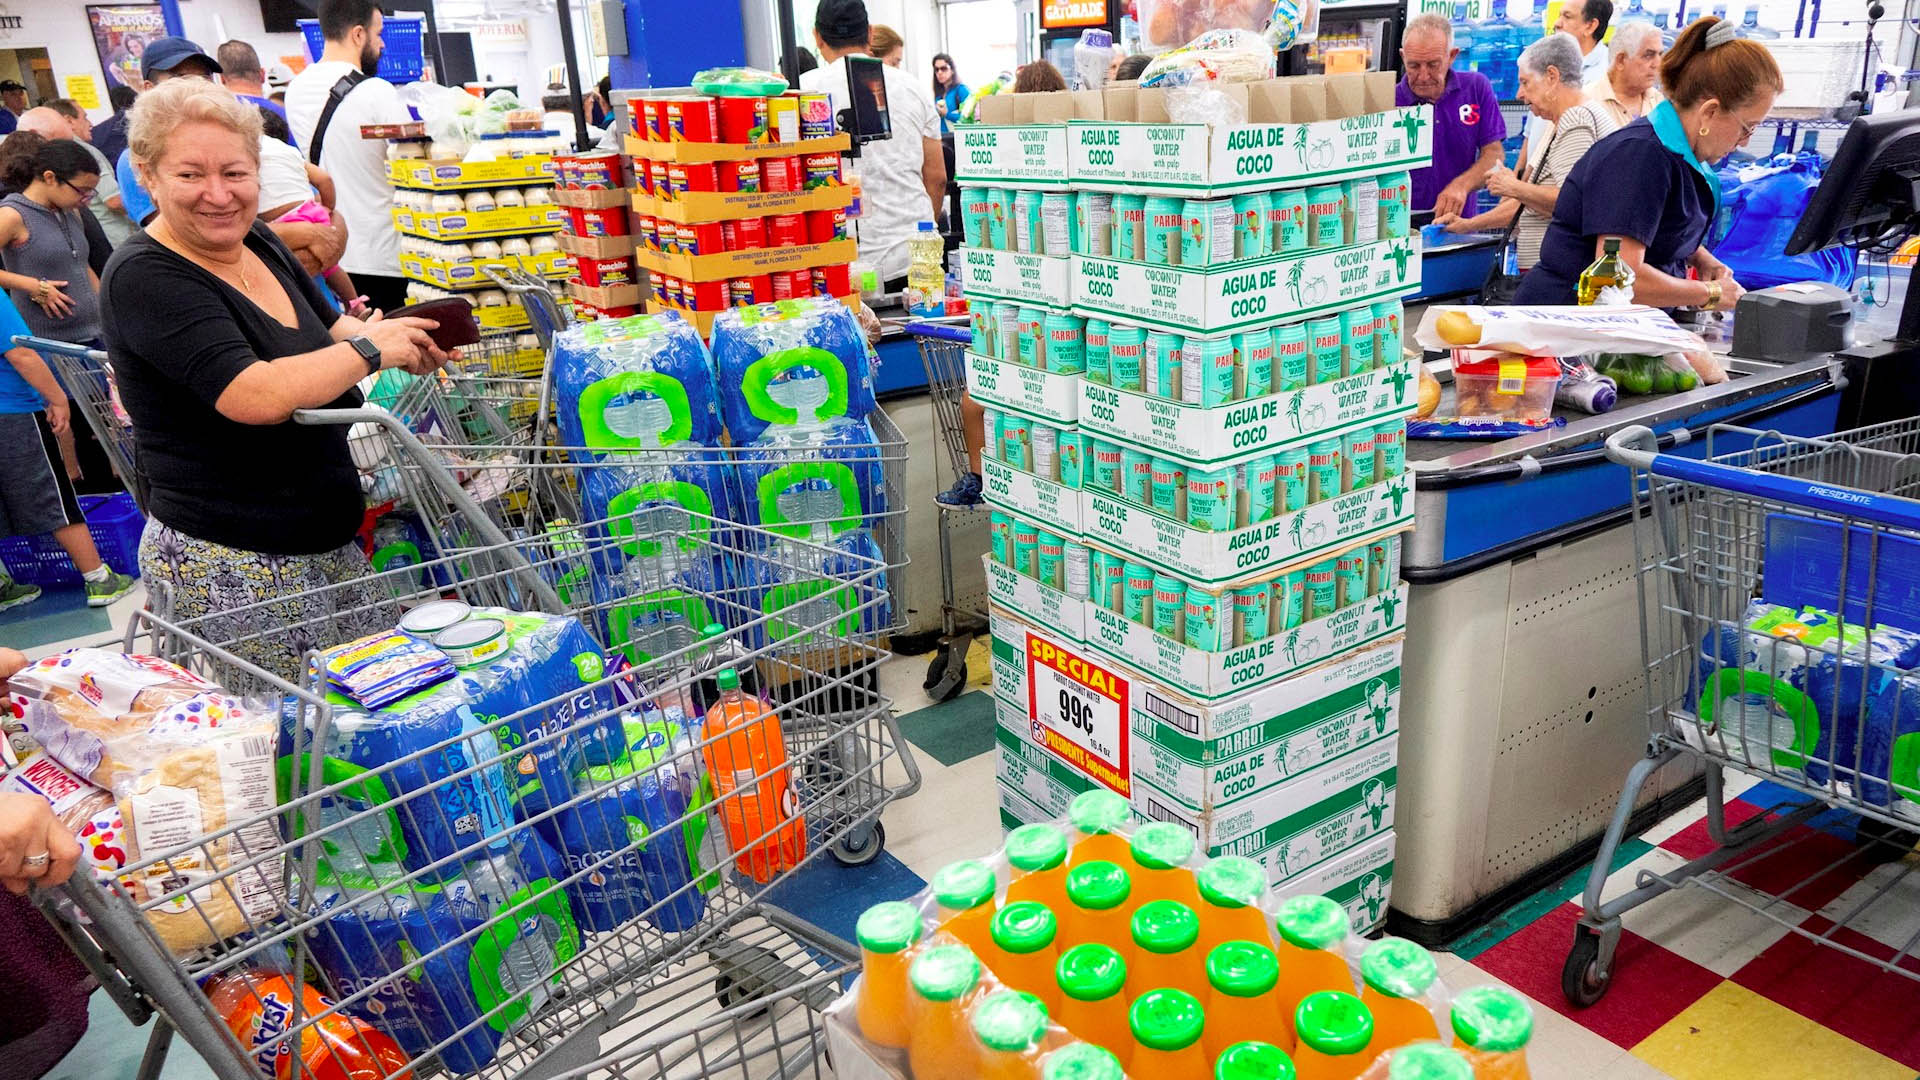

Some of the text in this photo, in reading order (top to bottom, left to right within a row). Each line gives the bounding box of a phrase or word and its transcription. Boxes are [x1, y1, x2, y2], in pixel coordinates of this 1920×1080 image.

[1046, 2, 1104, 19] GATORADE
[1340, 114, 1385, 132] COCONUT
[965, 133, 997, 147] AGUA DE
[1018, 131, 1048, 142] COCONUT
[1081, 130, 1120, 145] AGUA DE
[1146, 128, 1186, 141] COCONUT
[1227, 127, 1284, 151] AGUA DE
[1347, 132, 1377, 148] WATER
[971, 151, 992, 165] COCO
[1024, 144, 1045, 156] WATER
[1088, 150, 1114, 165] COCO
[1152, 144, 1180, 156] WATER
[1347, 151, 1377, 163] with pulp
[806, 156, 838, 166] Conchita
[1153, 159, 1180, 170] with pulp
[1236, 154, 1273, 175] COCO
[597, 261, 628, 271] Conchita
[967, 252, 995, 267] AGUA DE
[1014, 255, 1042, 268] COCONUT
[973, 269, 992, 283] COCO
[1020, 268, 1041, 280] WATER
[1081, 261, 1119, 280] AGUA DE
[1145, 269, 1183, 285] COCONUT
[1088, 281, 1113, 298] COCO
[1151, 284, 1177, 298] WATER
[1222, 270, 1276, 297] AGUA DE
[1231, 296, 1266, 318] COCO
[1051, 330, 1080, 342] PARROT
[1112, 345, 1141, 357] PARROT
[972, 357, 999, 377] AGUA DE
[1018, 368, 1046, 384] COCONUT
[977, 374, 996, 391] COCO
[1023, 381, 1043, 395] WATER
[1332, 374, 1375, 395] COCONUT
[1085, 385, 1120, 408] AGUA DE
[1339, 391, 1367, 409] WATER
[1091, 406, 1115, 423] COCO
[1145, 400, 1181, 419] COCONUT
[1224, 401, 1277, 429] AGUA DE
[1151, 415, 1176, 431] WATER
[1233, 427, 1267, 448] COCO
[985, 462, 1013, 483] AGUA DE
[989, 479, 1009, 496] COCO
[1032, 479, 1060, 497] COCONUT
[1808, 486, 1872, 506] PRESIDENTE
[1037, 491, 1057, 507] WATER
[1332, 490, 1375, 513] COCONUT
[1093, 498, 1116, 517] AGUA
[1116, 506, 1128, 522] DE
[1338, 506, 1367, 524] WATER
[1100, 517, 1122, 535] COCO
[1151, 518, 1185, 539] COCONUT
[1157, 532, 1181, 549] WATER
[1228, 522, 1281, 551] AGUA DE
[1237, 546, 1270, 569] COCO
[990, 563, 1018, 586] AGUA DE
[996, 579, 1015, 597] COCO
[1095, 609, 1129, 635] AGUA DE
[1101, 628, 1123, 647] COCO
[1152, 634, 1186, 654] COCONUT
[581, 656, 599, 673] 24
[1158, 649, 1182, 666] WATER
[1223, 640, 1275, 671] AGUA DE
[994, 662, 1021, 686] AGUA DE
[1030, 638, 1121, 700] SPECIAL
[1231, 663, 1265, 686] COCO
[79, 680, 104, 704] WONDER
[999, 677, 1017, 696] COCO
[1053, 671, 1100, 704] PARROT COCONUT WATER
[1059, 689, 1094, 737] 99¢
[1132, 709, 1158, 738] RROT
[1316, 713, 1357, 739] COCONUT
[1090, 738, 1111, 758] 16.4 oz
[1216, 722, 1266, 759] PARROT
[1322, 729, 1351, 749] WATER
[1046, 730, 1085, 765] PRESIDENTE
[1085, 751, 1130, 794] Supermarket
[1150, 747, 1181, 770] COCONUT
[1155, 761, 1178, 778] WATER
[1214, 753, 1265, 784] AGUA DE
[23, 758, 81, 800] WONDER
[1223, 775, 1256, 798] COCO
[629, 823, 644, 836] 24
[1315, 813, 1355, 840] COCONUT
[1321, 827, 1348, 848] WATER
